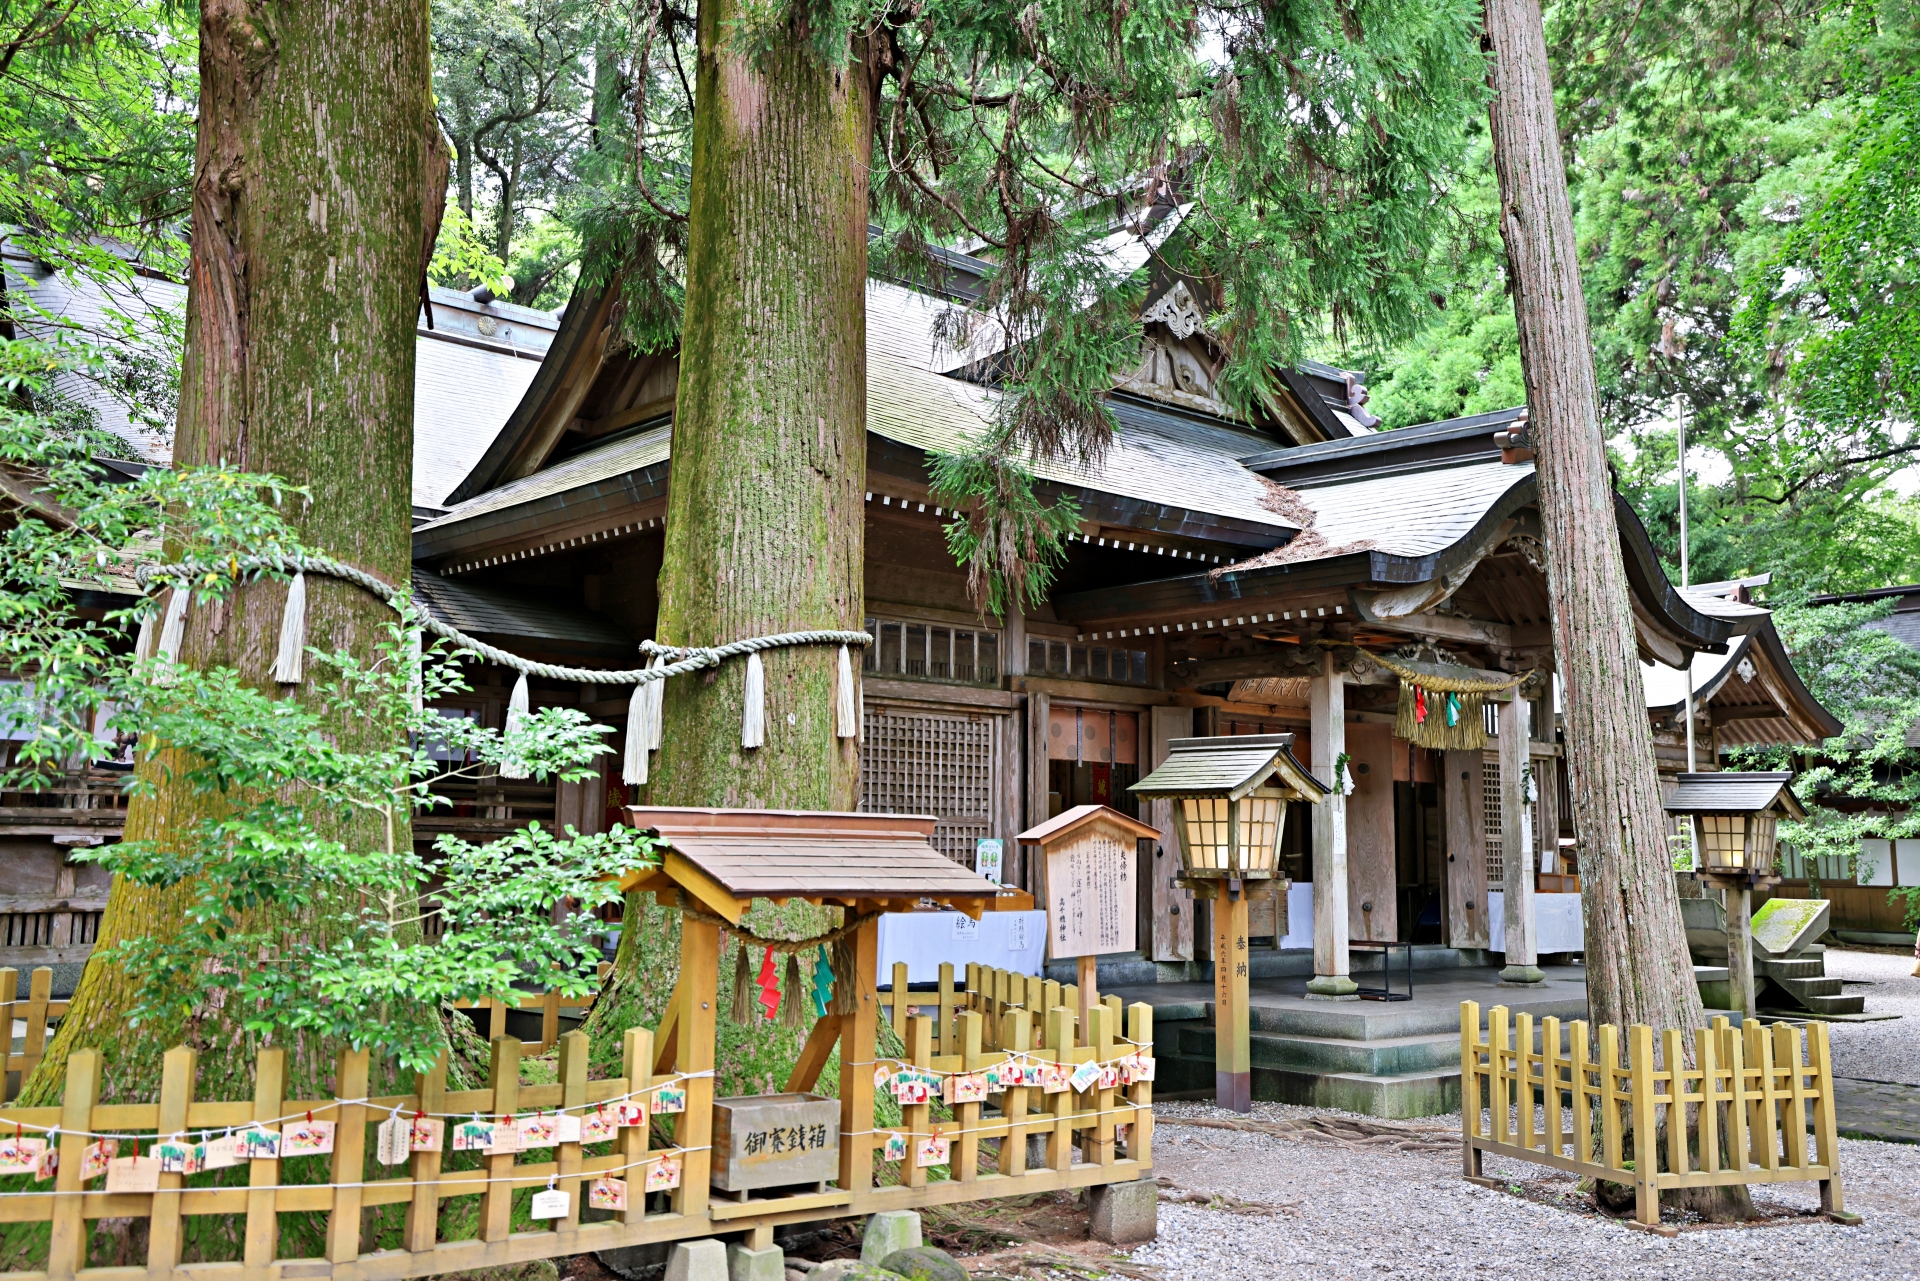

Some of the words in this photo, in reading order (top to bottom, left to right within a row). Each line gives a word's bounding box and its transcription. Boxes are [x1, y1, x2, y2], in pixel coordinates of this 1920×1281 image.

[1236, 934, 1247, 978] 奉納
[743, 1123, 827, 1156] 御賽銭箱
